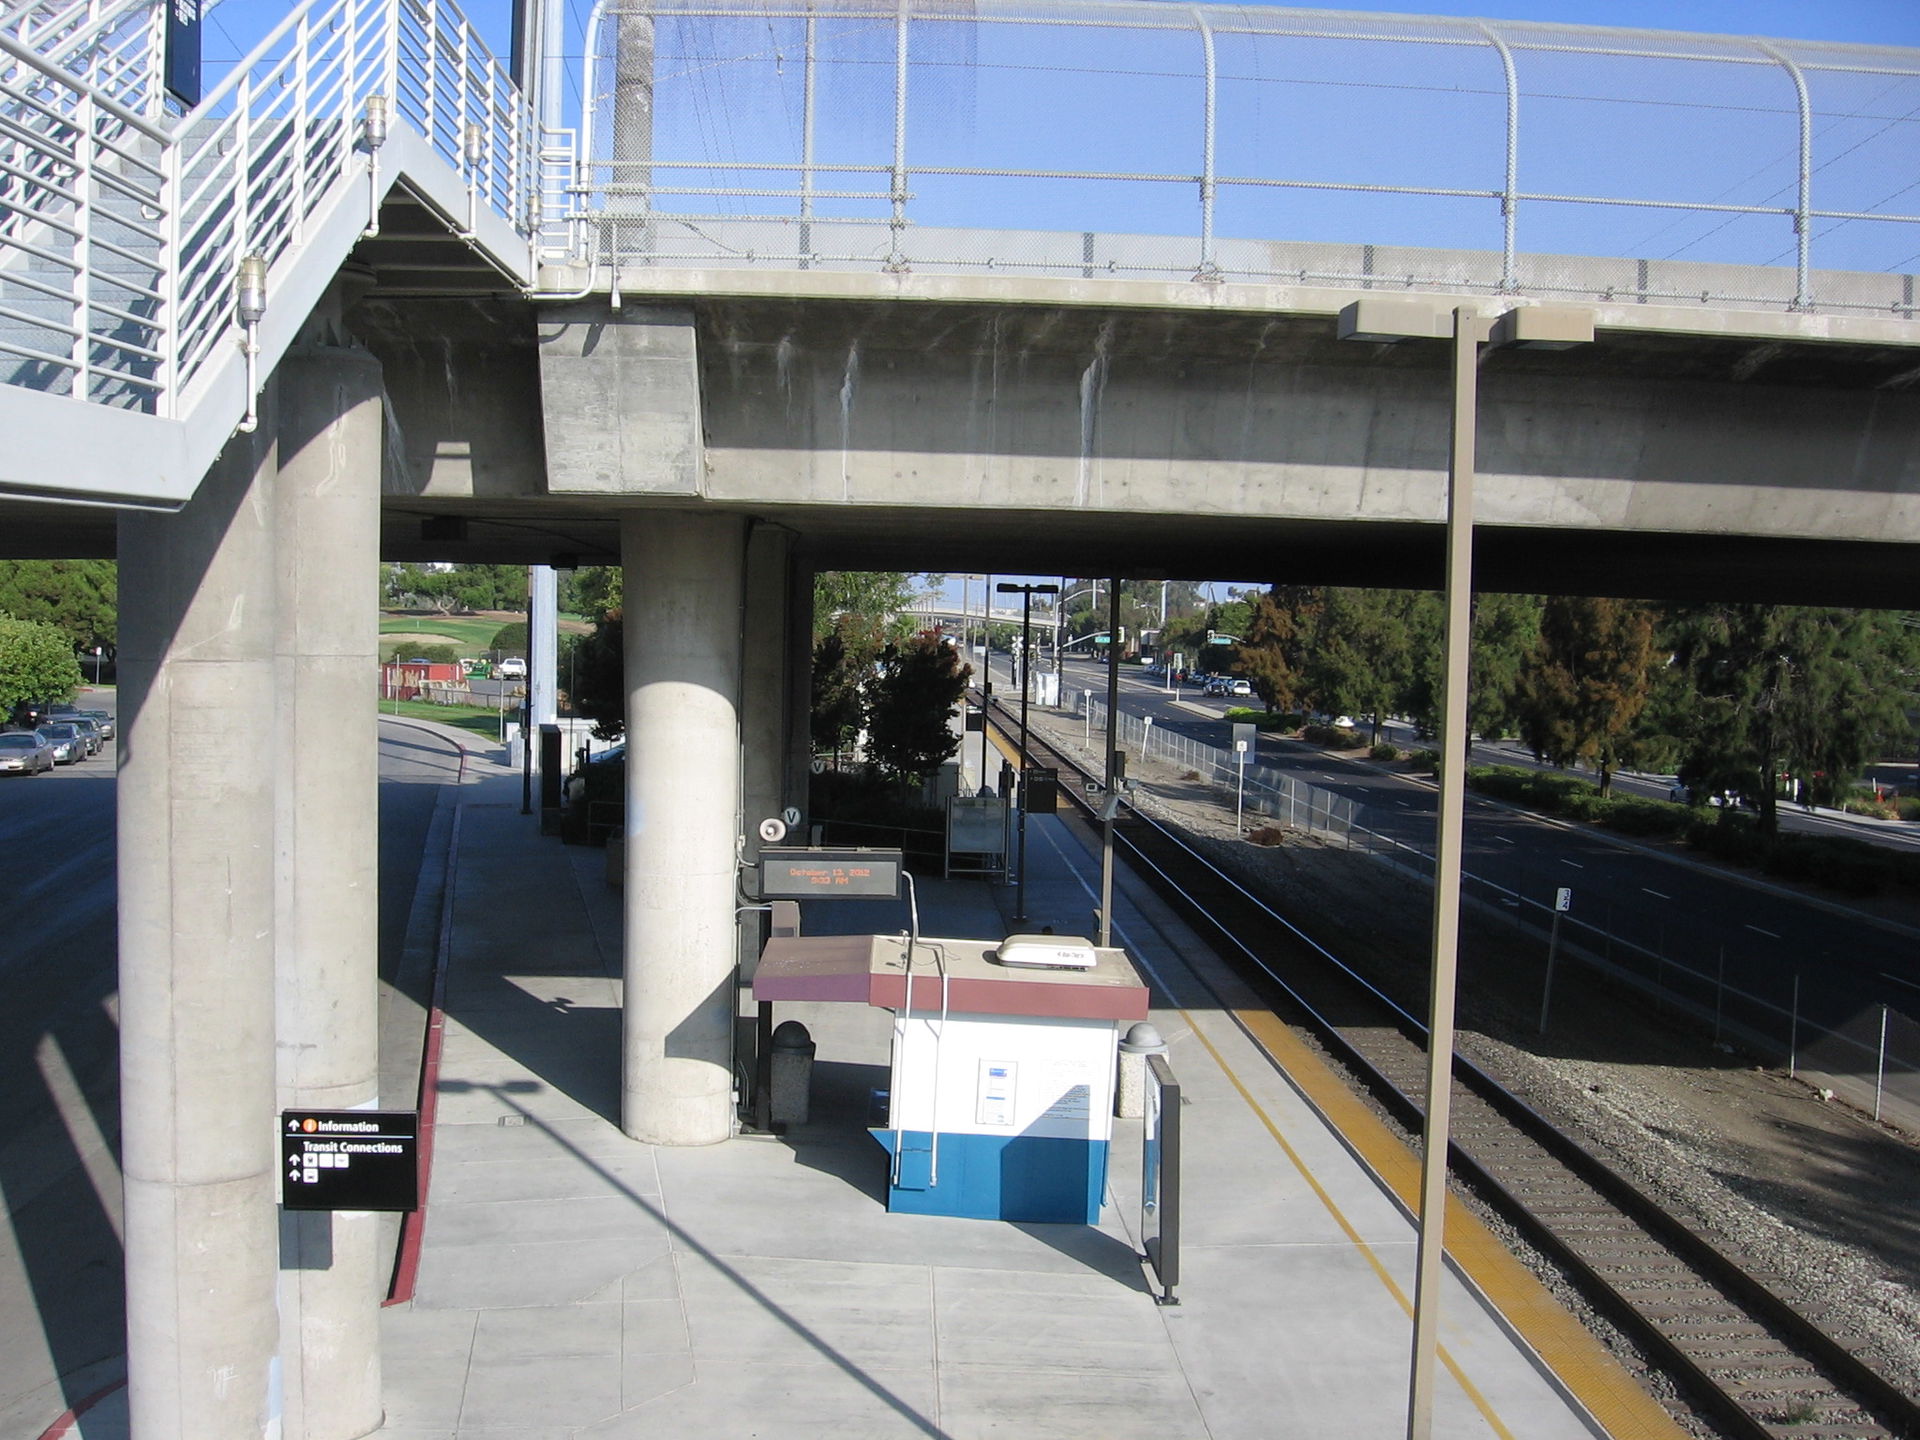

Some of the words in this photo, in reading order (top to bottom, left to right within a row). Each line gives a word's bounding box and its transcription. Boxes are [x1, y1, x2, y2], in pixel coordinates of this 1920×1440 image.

[786, 810, 797, 824] V
[790, 868, 828, 876] October
[318, 1120, 380, 1133] Information
[303, 1141, 338, 1152] Transit
[340, 1142, 404, 1154] Connections
